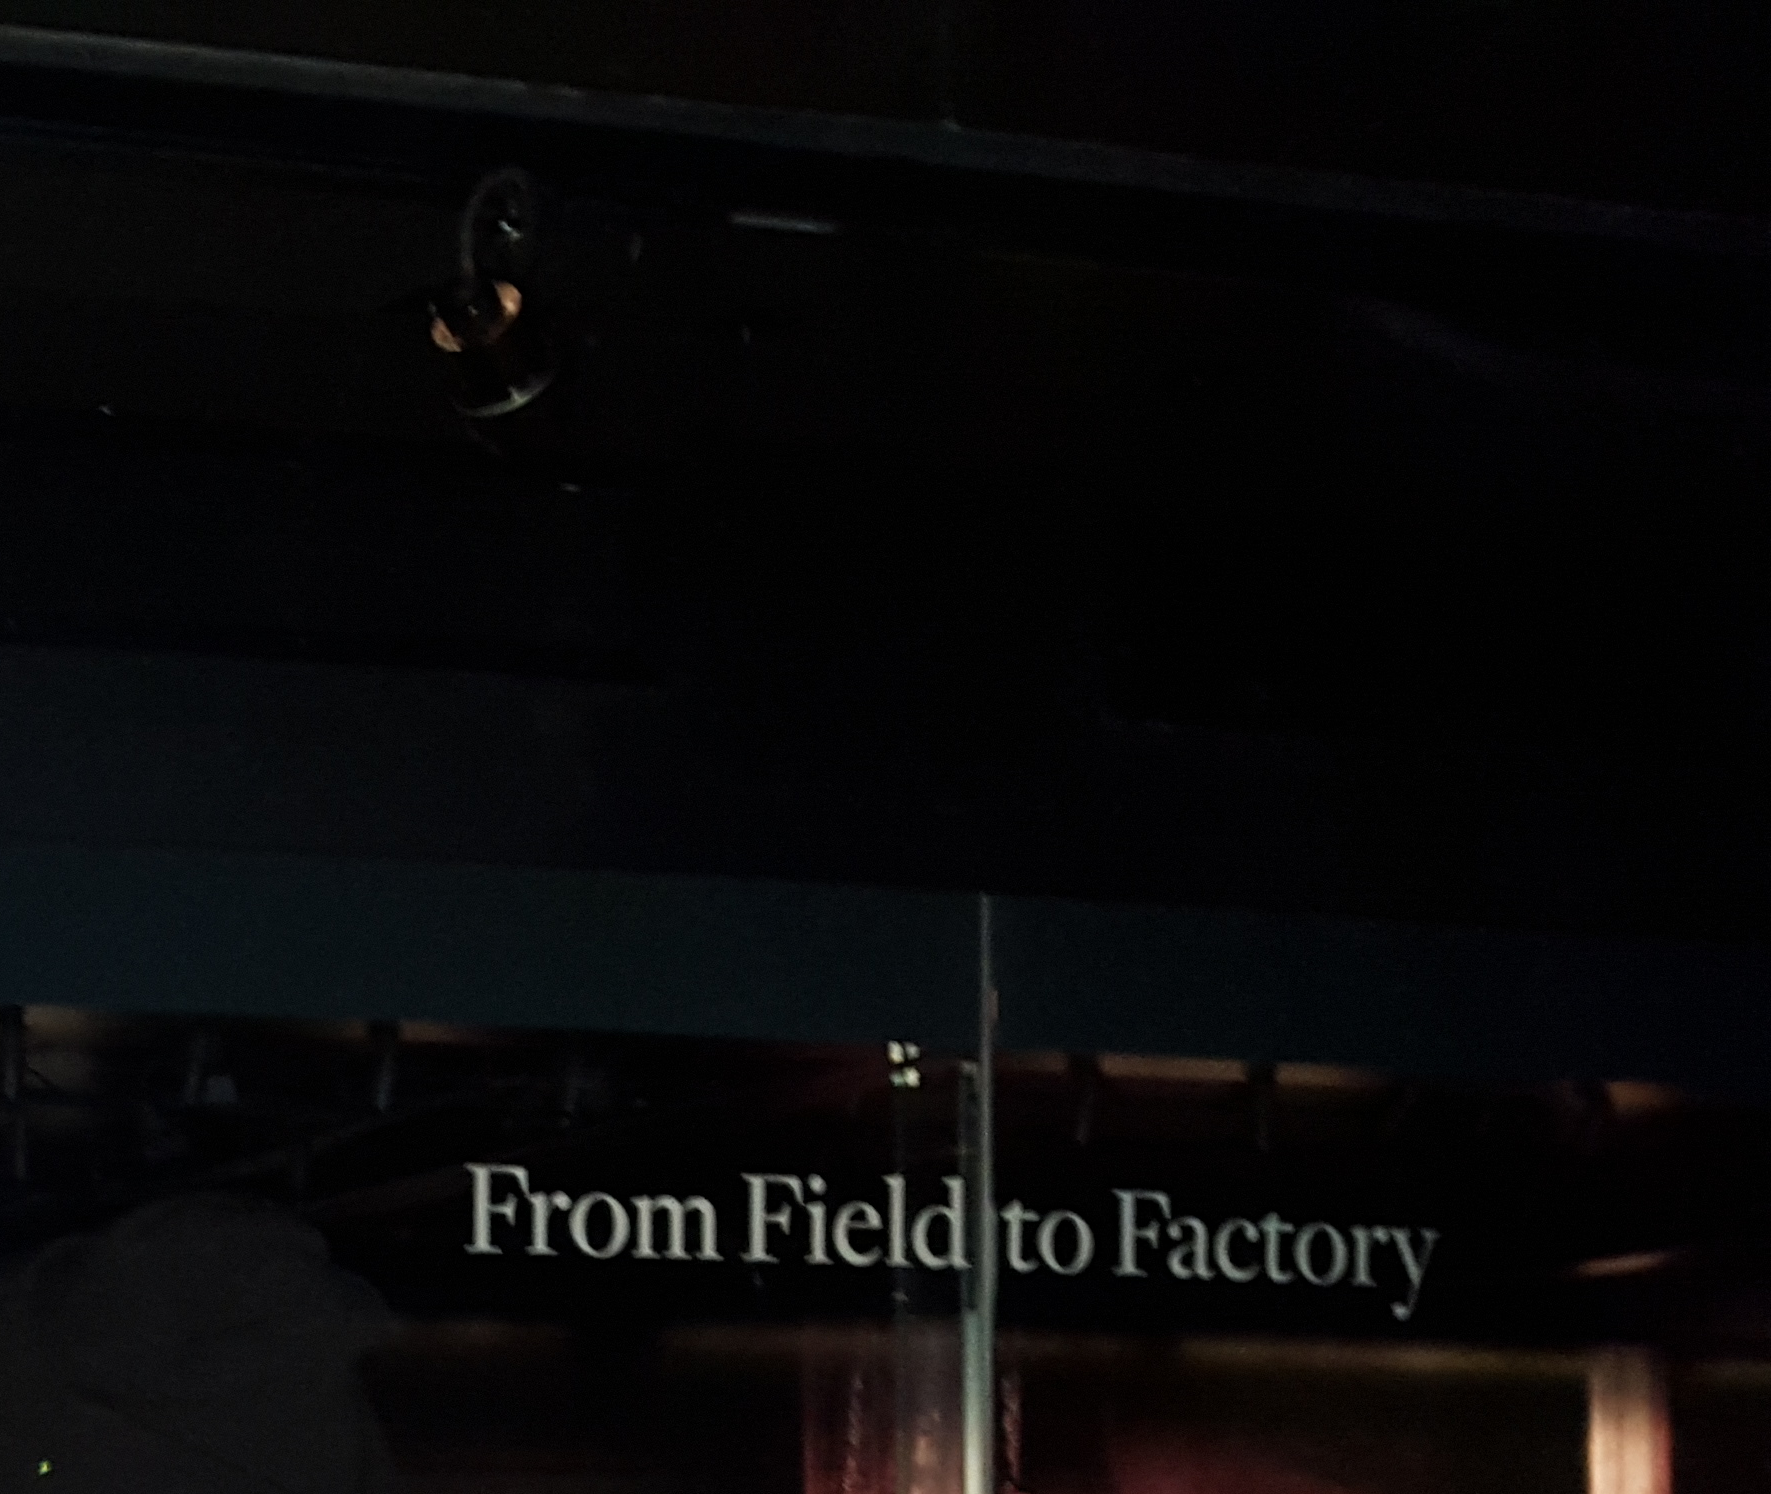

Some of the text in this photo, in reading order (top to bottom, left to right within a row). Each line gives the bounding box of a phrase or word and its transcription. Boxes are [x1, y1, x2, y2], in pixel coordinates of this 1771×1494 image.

[463, 1162, 1441, 1321] From Field to Factory
